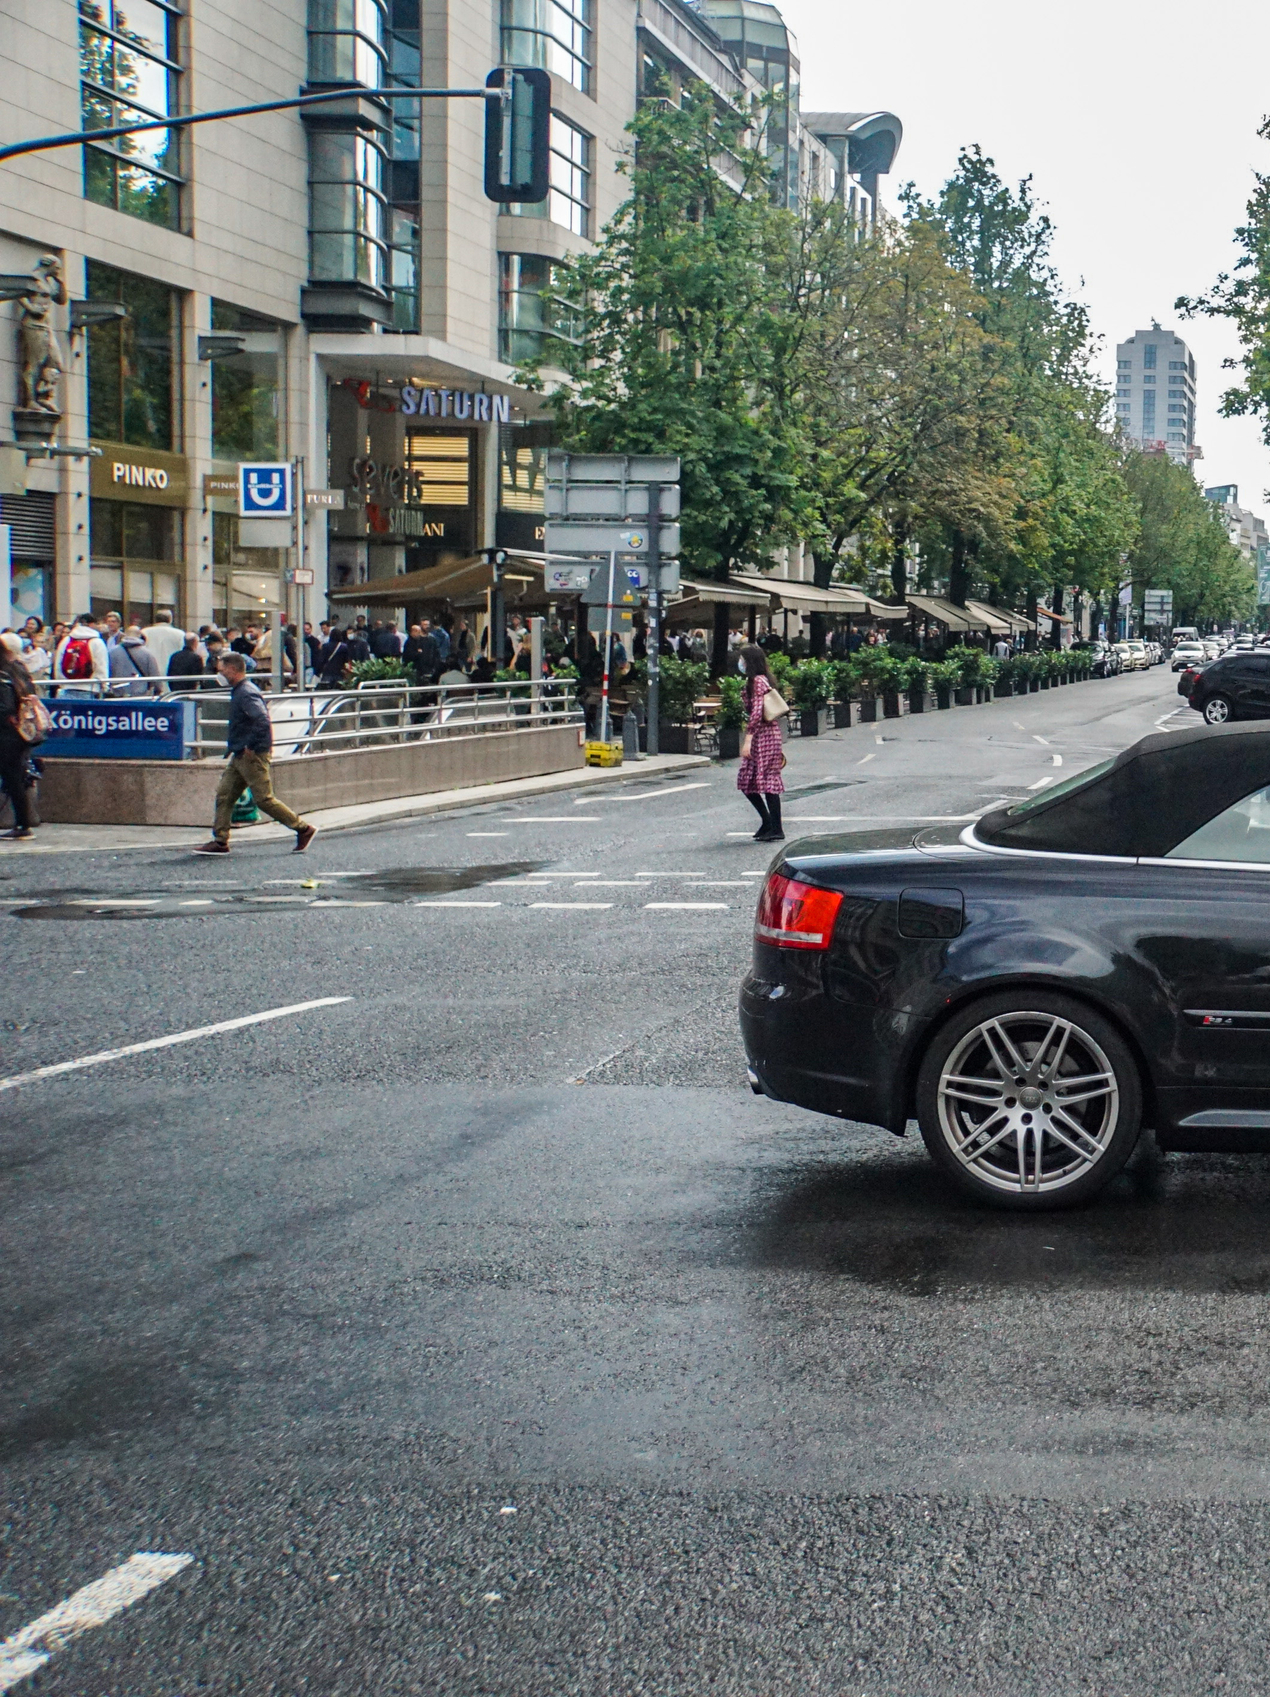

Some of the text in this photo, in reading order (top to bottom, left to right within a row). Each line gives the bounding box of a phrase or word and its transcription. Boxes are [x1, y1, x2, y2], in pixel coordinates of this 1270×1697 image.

[401, 386, 511, 423] SATURN
[112, 462, 169, 489] PINKO
[388, 506, 424, 537] SATURN
[49, 710, 169, 735] Königsallee
